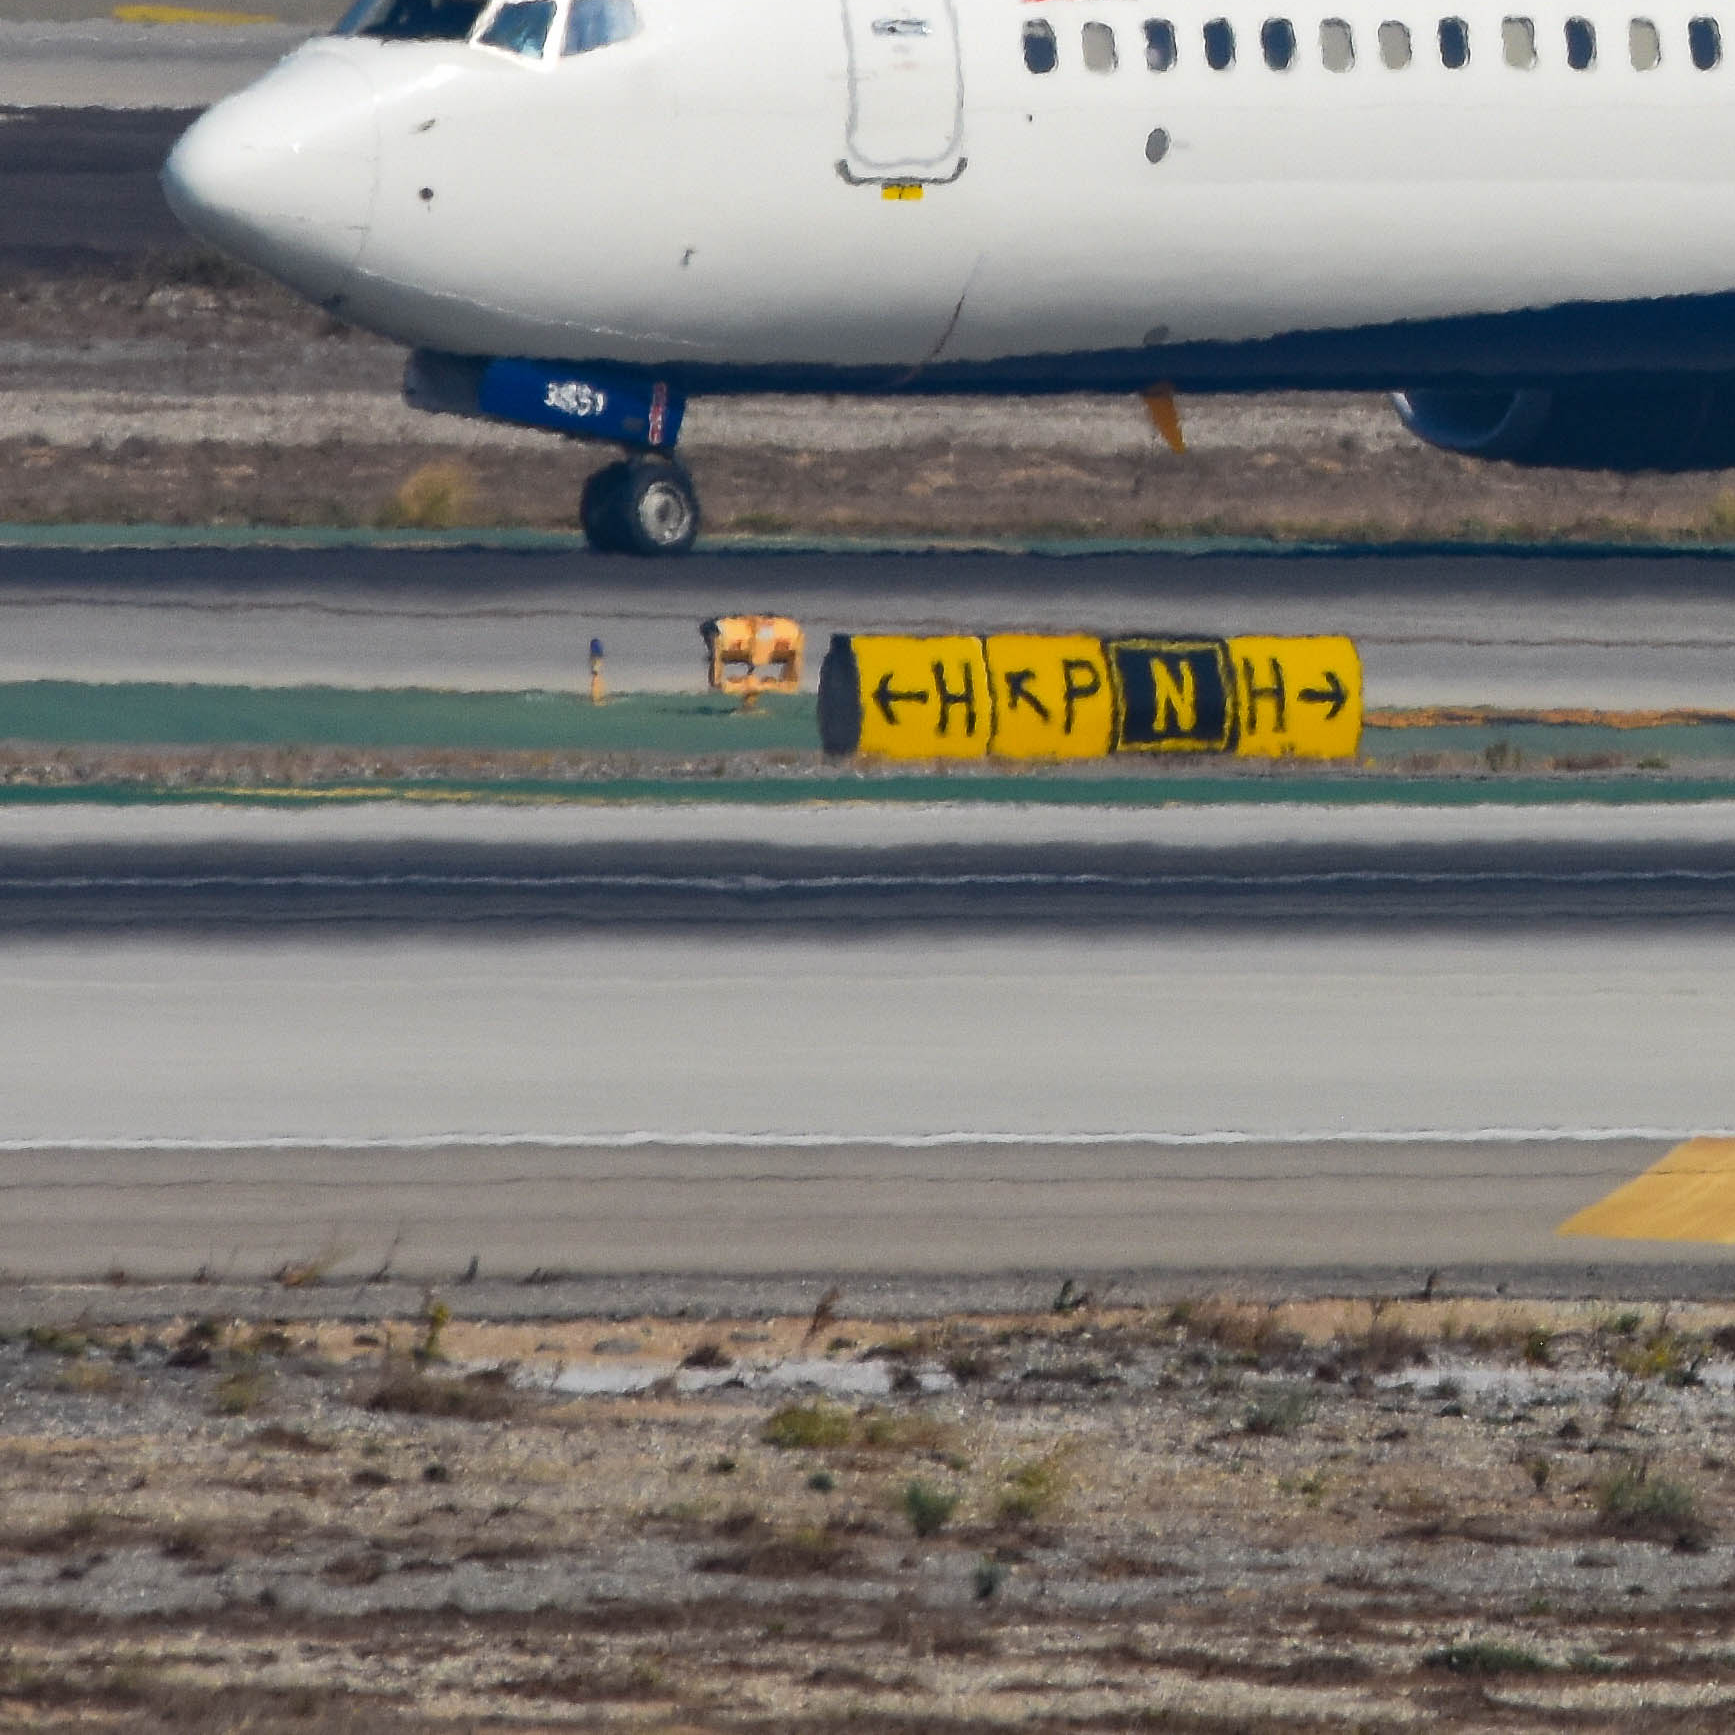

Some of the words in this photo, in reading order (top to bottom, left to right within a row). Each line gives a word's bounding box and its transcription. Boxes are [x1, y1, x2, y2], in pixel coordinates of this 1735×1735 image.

[933, 657, 977, 738] H
[1062, 659, 1102, 736] P
[1151, 660, 1197, 734] N
[1243, 657, 1286, 735] H
